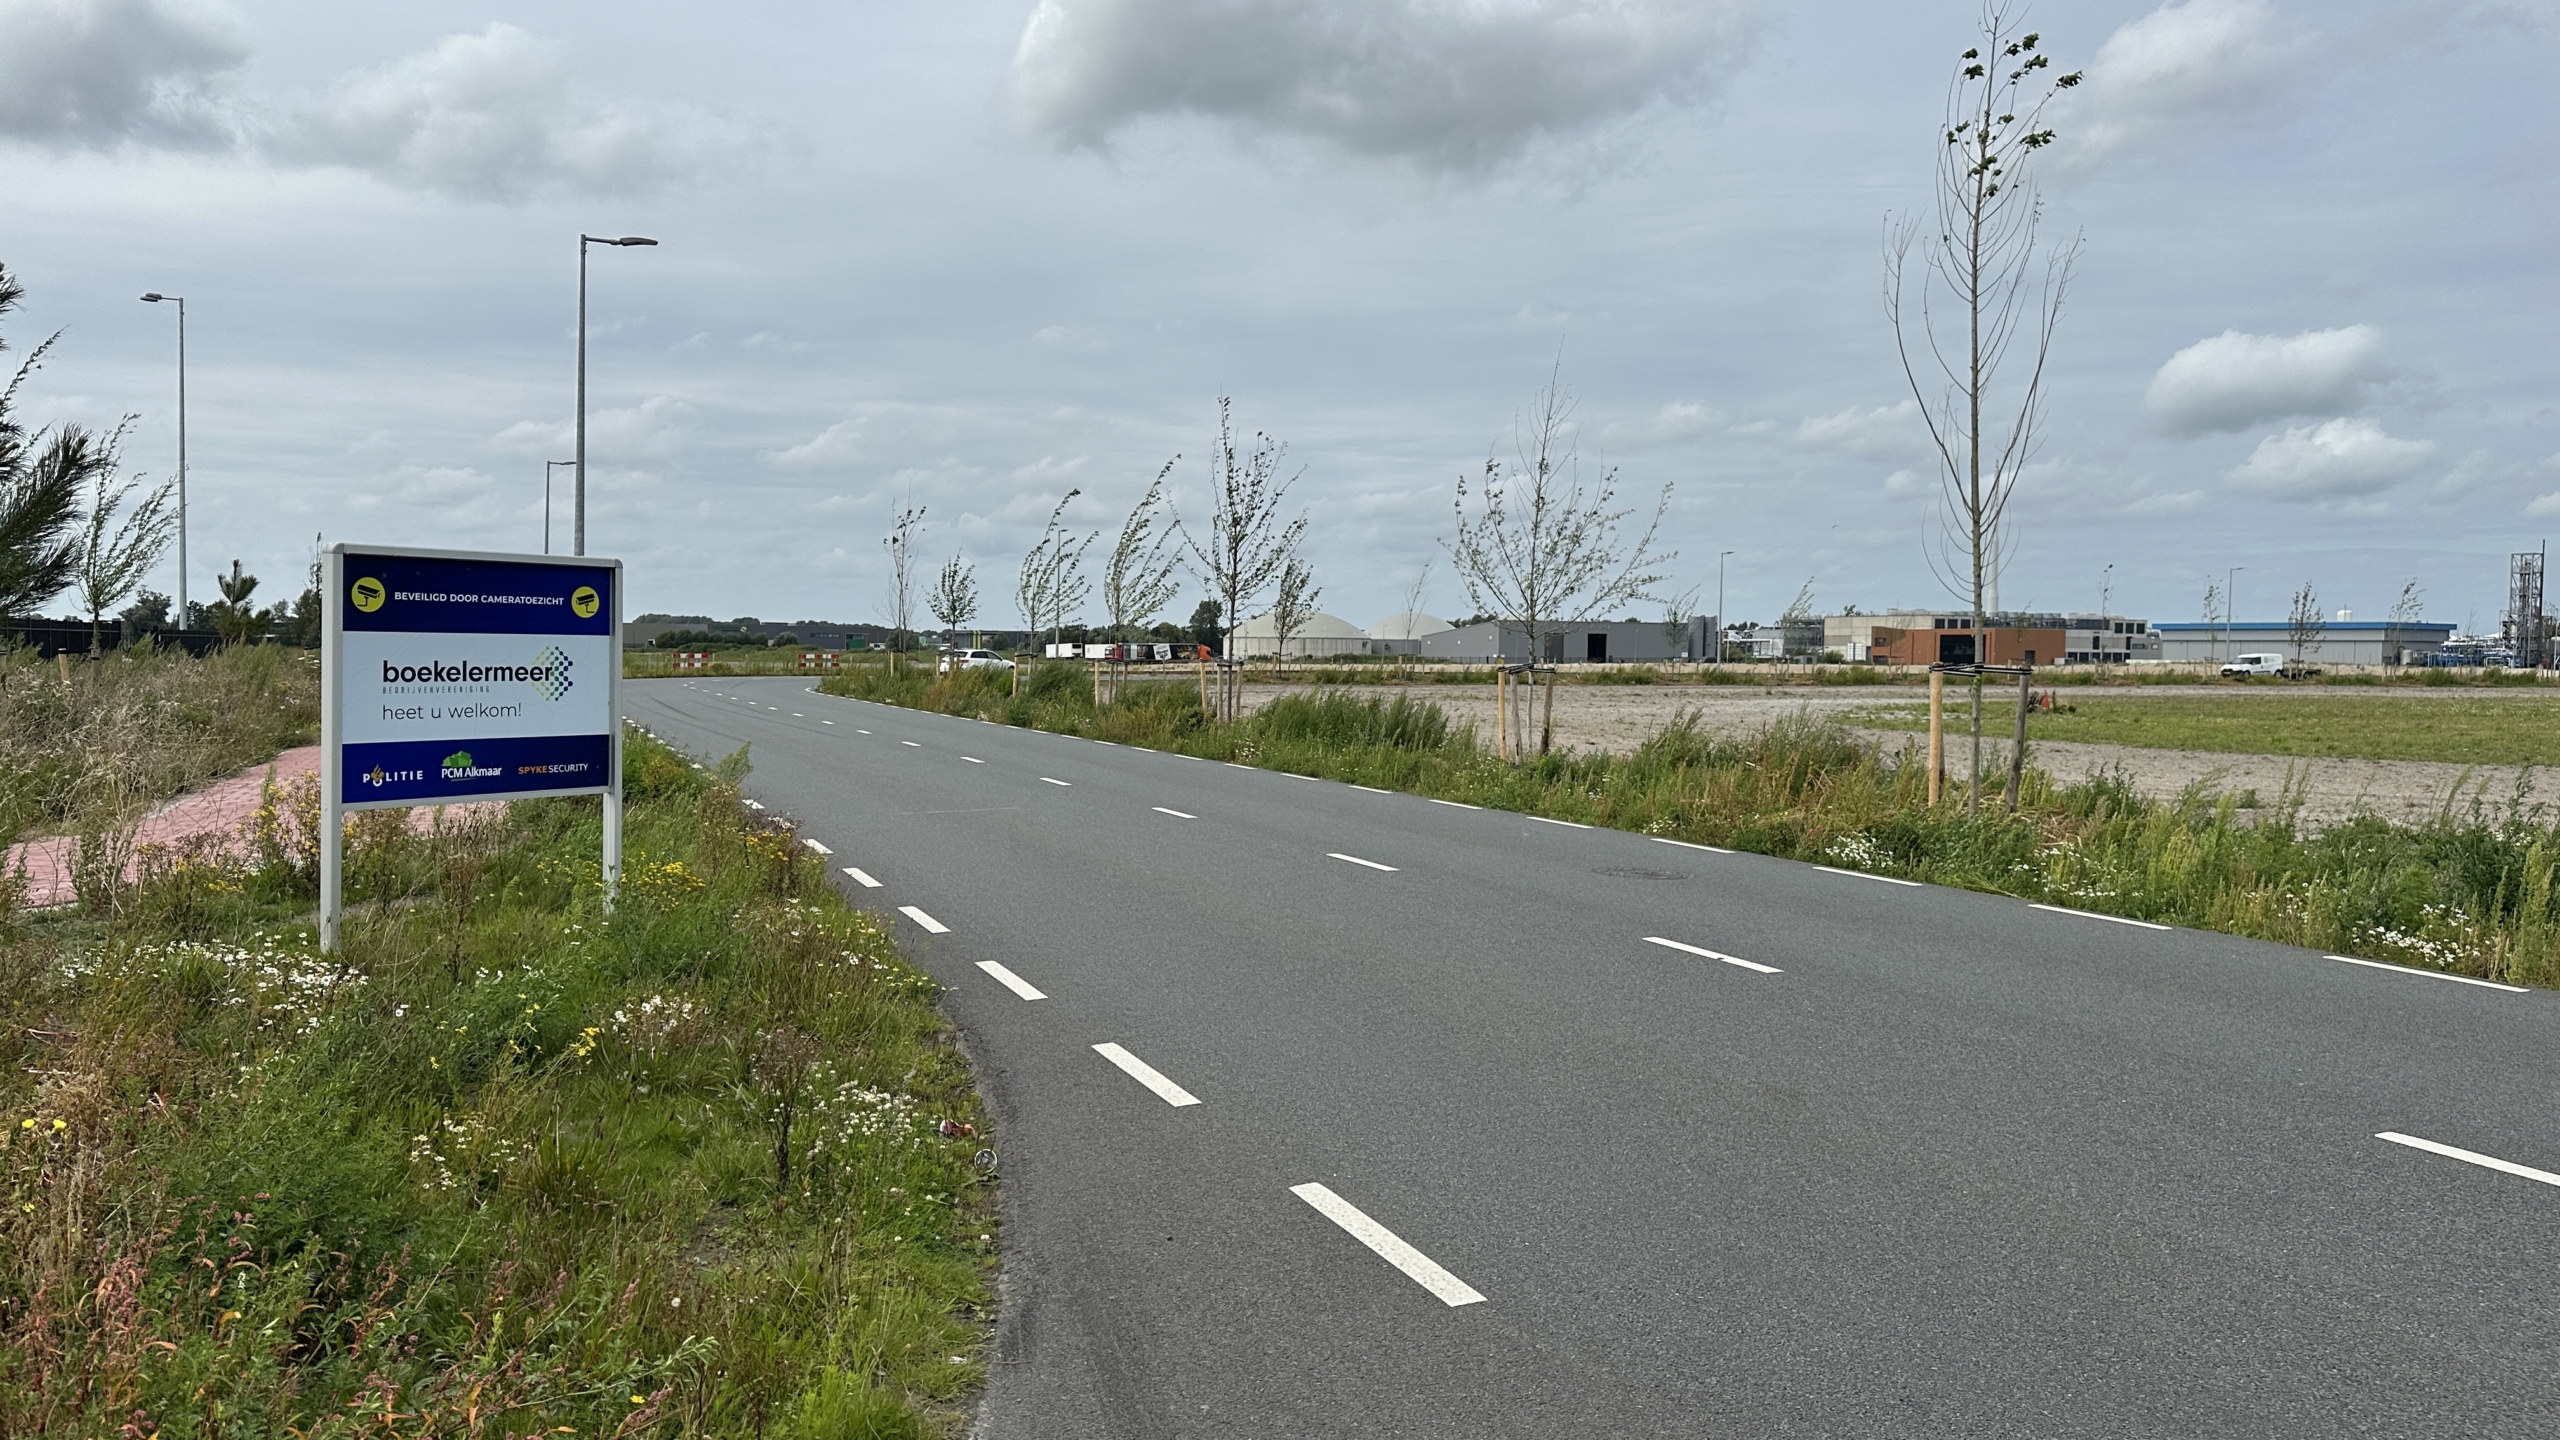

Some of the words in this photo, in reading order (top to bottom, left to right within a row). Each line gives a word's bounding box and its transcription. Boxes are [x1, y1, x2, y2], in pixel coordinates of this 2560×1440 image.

[394, 592, 447, 602] BEVEILIGD
[449, 594, 479, 602] DOOR
[480, 595, 564, 605] CAMERATOEZICHT
[383, 660, 552, 683] boekelermeer
[382, 686, 490, 694] BEDRIJVENVERENIGING
[382, 704, 424, 720] heet
[431, 707, 442, 719] u
[448, 703, 522, 718] welkom!
[441, 768, 463, 779] PCM
[464, 766, 502, 778] Alkmaar
